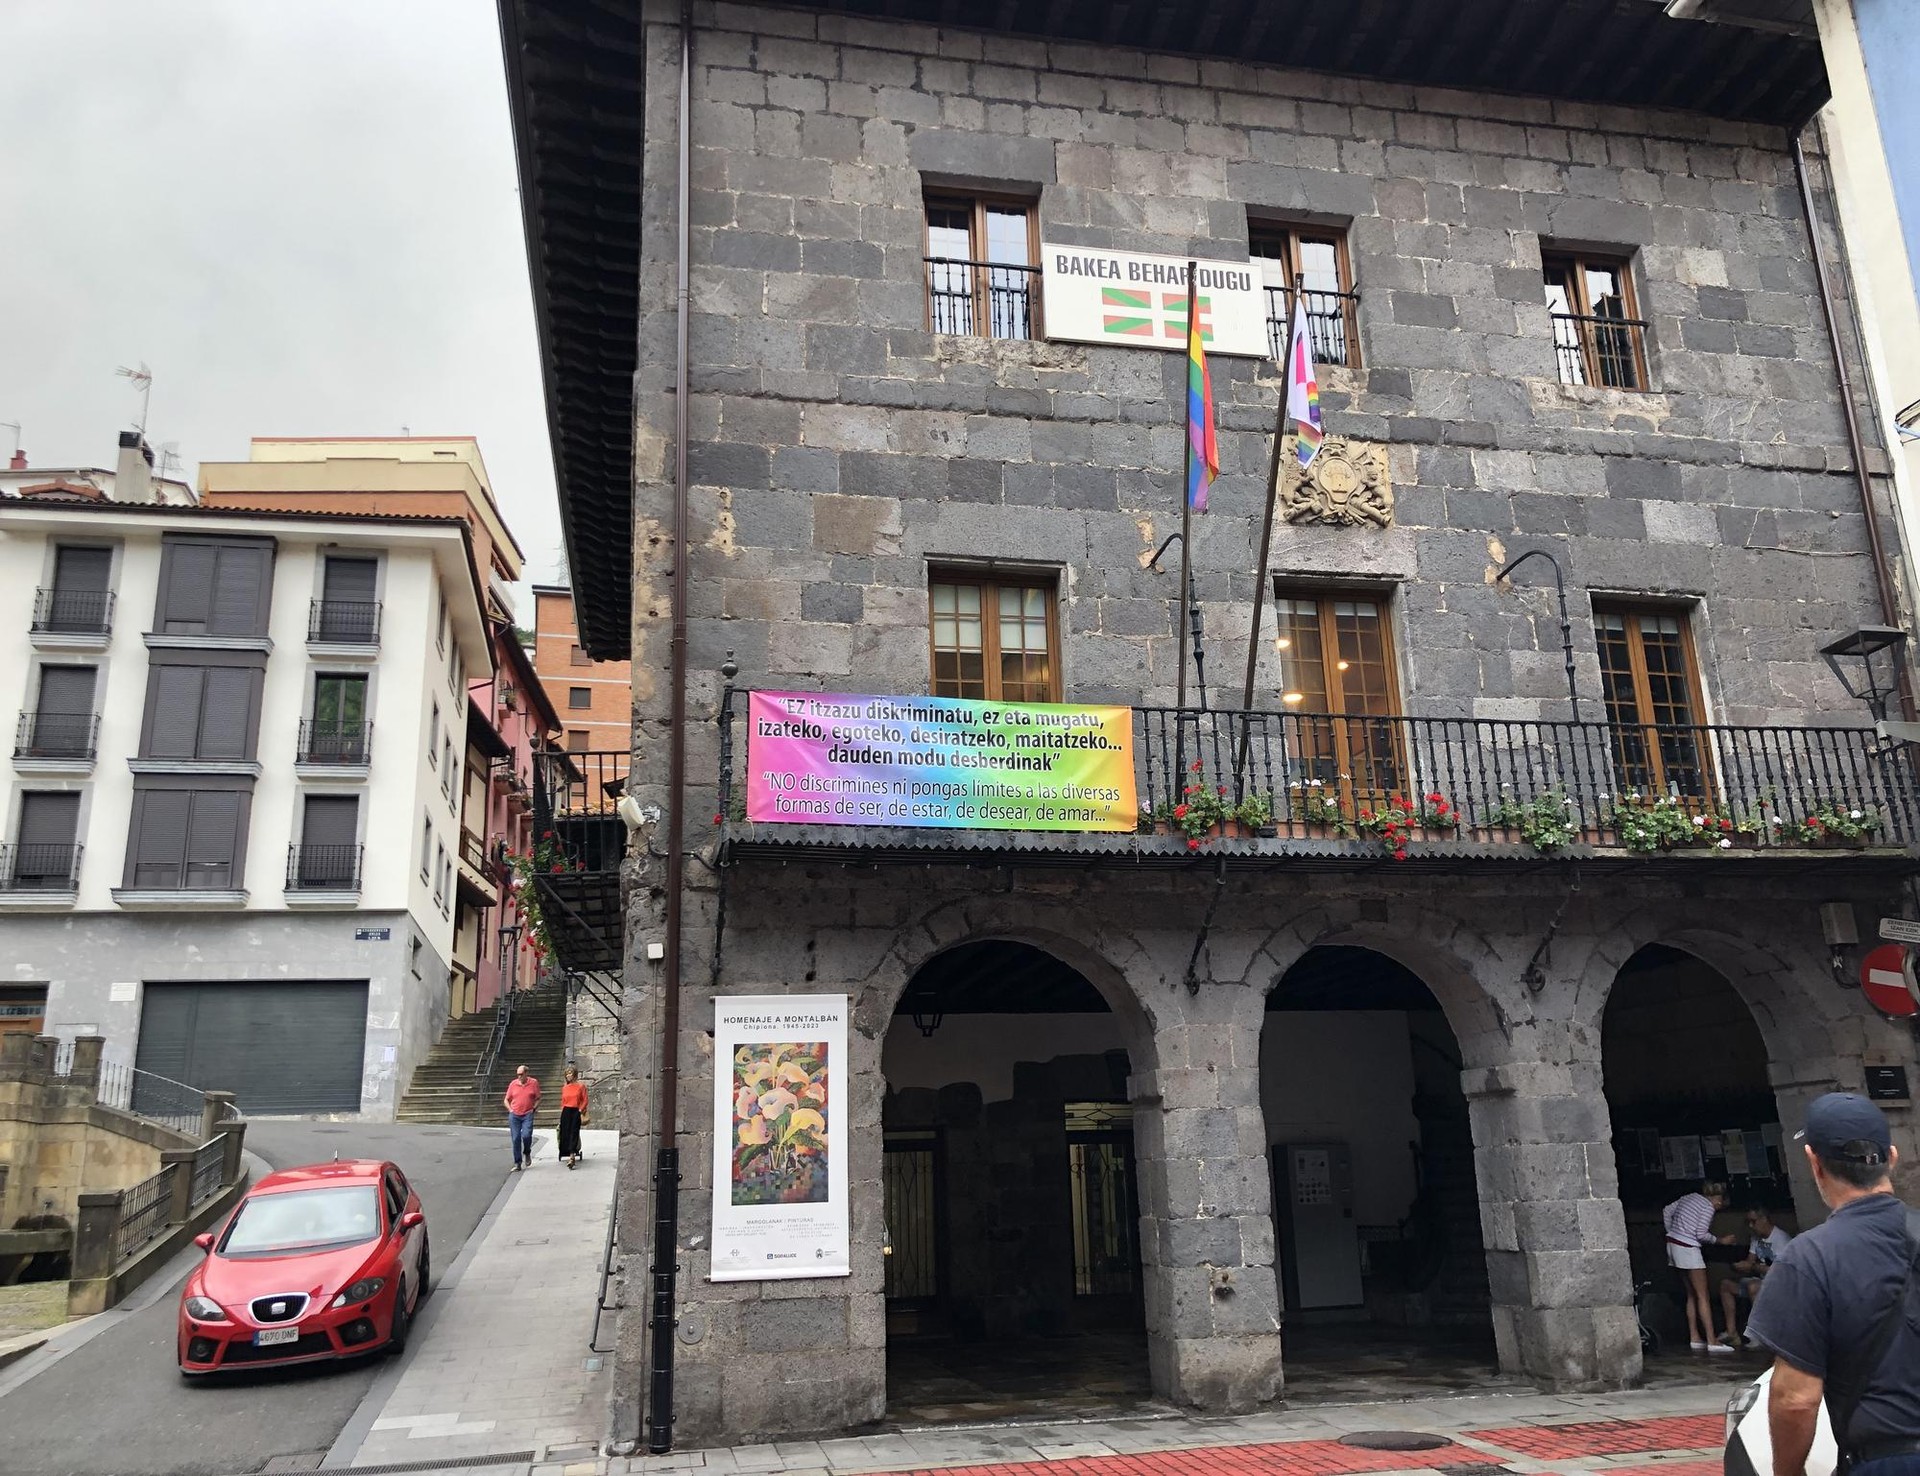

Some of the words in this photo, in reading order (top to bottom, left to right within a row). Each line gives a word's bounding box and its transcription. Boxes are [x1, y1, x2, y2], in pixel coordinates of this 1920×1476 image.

[1056, 254, 1122, 280] BAKEA
[1128, 261, 1190, 286] BEHAR
[1199, 268, 1252, 292] DUGU
[810, 699, 862, 719] itzazu
[866, 701, 978, 727] diskriminatu,
[982, 711, 1000, 725] ez
[1004, 710, 1031, 725] eta
[1035, 713, 1105, 731] mugatu,
[758, 717, 827, 742] izateko,
[831, 723, 906, 745] egoteko,
[910, 726, 1011, 750] desiratzeko,
[1015, 730, 1123, 751] maitatzeko...
[828, 743, 893, 765] dauden
[897, 747, 946, 767] modu
[800, 773, 888, 795] discrimines
[893, 778, 907, 795] ni
[911, 781, 968, 801] pongas
[972, 779, 1021, 798] límites
[1025, 786, 1034, 799] a
[1038, 782, 1058, 799] las
[1061, 783, 1120, 801] diversas
[775, 794, 830, 813] formas
[835, 796, 854, 815] de
[859, 801, 884, 819] ser,
[888, 799, 908, 816] de
[912, 802, 952, 820] estar,
[956, 800, 975, 818] de
[980, 801, 1032, 822] desear,
[1036, 803, 1055, 820] de
[723, 1015, 772, 1024] HOMENAJE
